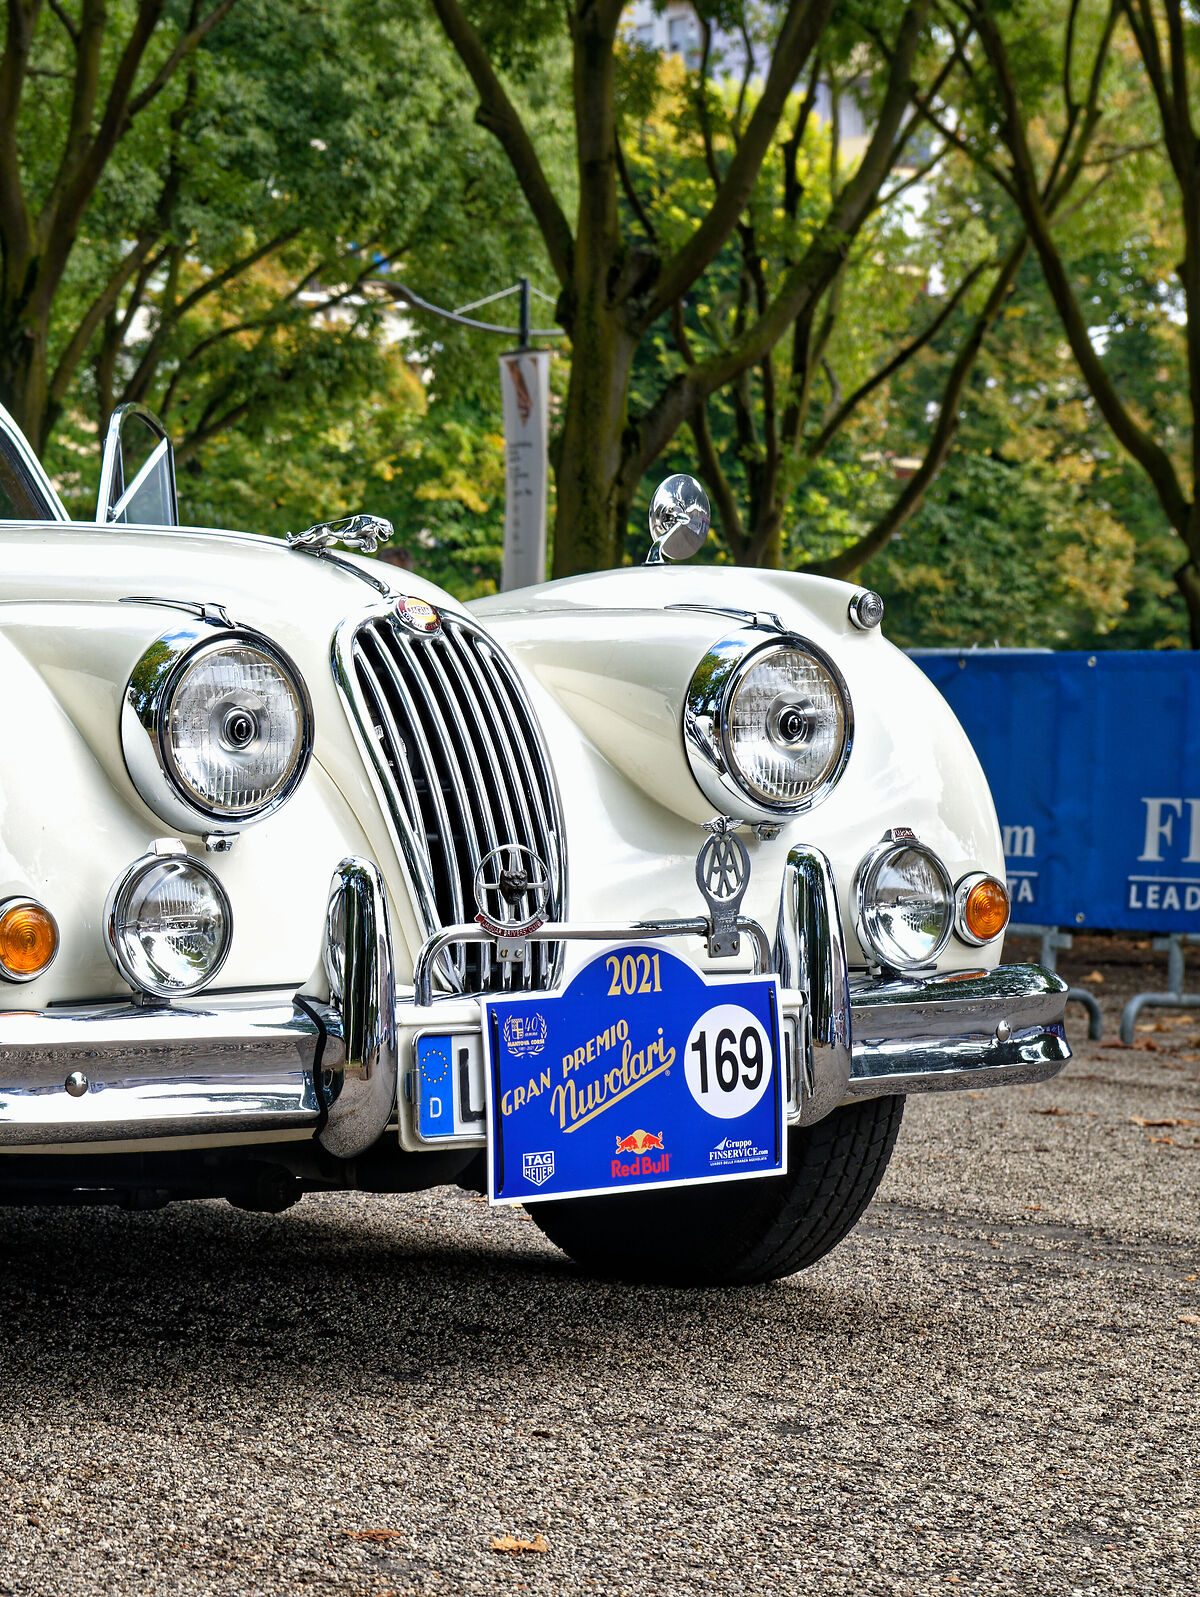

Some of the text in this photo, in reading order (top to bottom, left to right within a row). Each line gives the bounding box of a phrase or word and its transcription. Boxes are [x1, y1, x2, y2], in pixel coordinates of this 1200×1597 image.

[482, 921, 502, 935] JAGUAR
[528, 920, 542, 933] CLUB
[606, 953, 662, 996] 2021
[501, 1019, 629, 1116] GRAN PREMIO
[690, 1025, 764, 1094] 169
[550, 1027, 676, 1131] Nuvolari
[429, 1097, 442, 1118] D
[709, 1147, 768, 1161] FINSERVICE.com
[726, 1139, 752, 1149] Gruppo
[525, 1153, 552, 1166] TAG
[611, 1153, 670, 1178] Red Bull
[524, 1166, 553, 1182] HEUER
